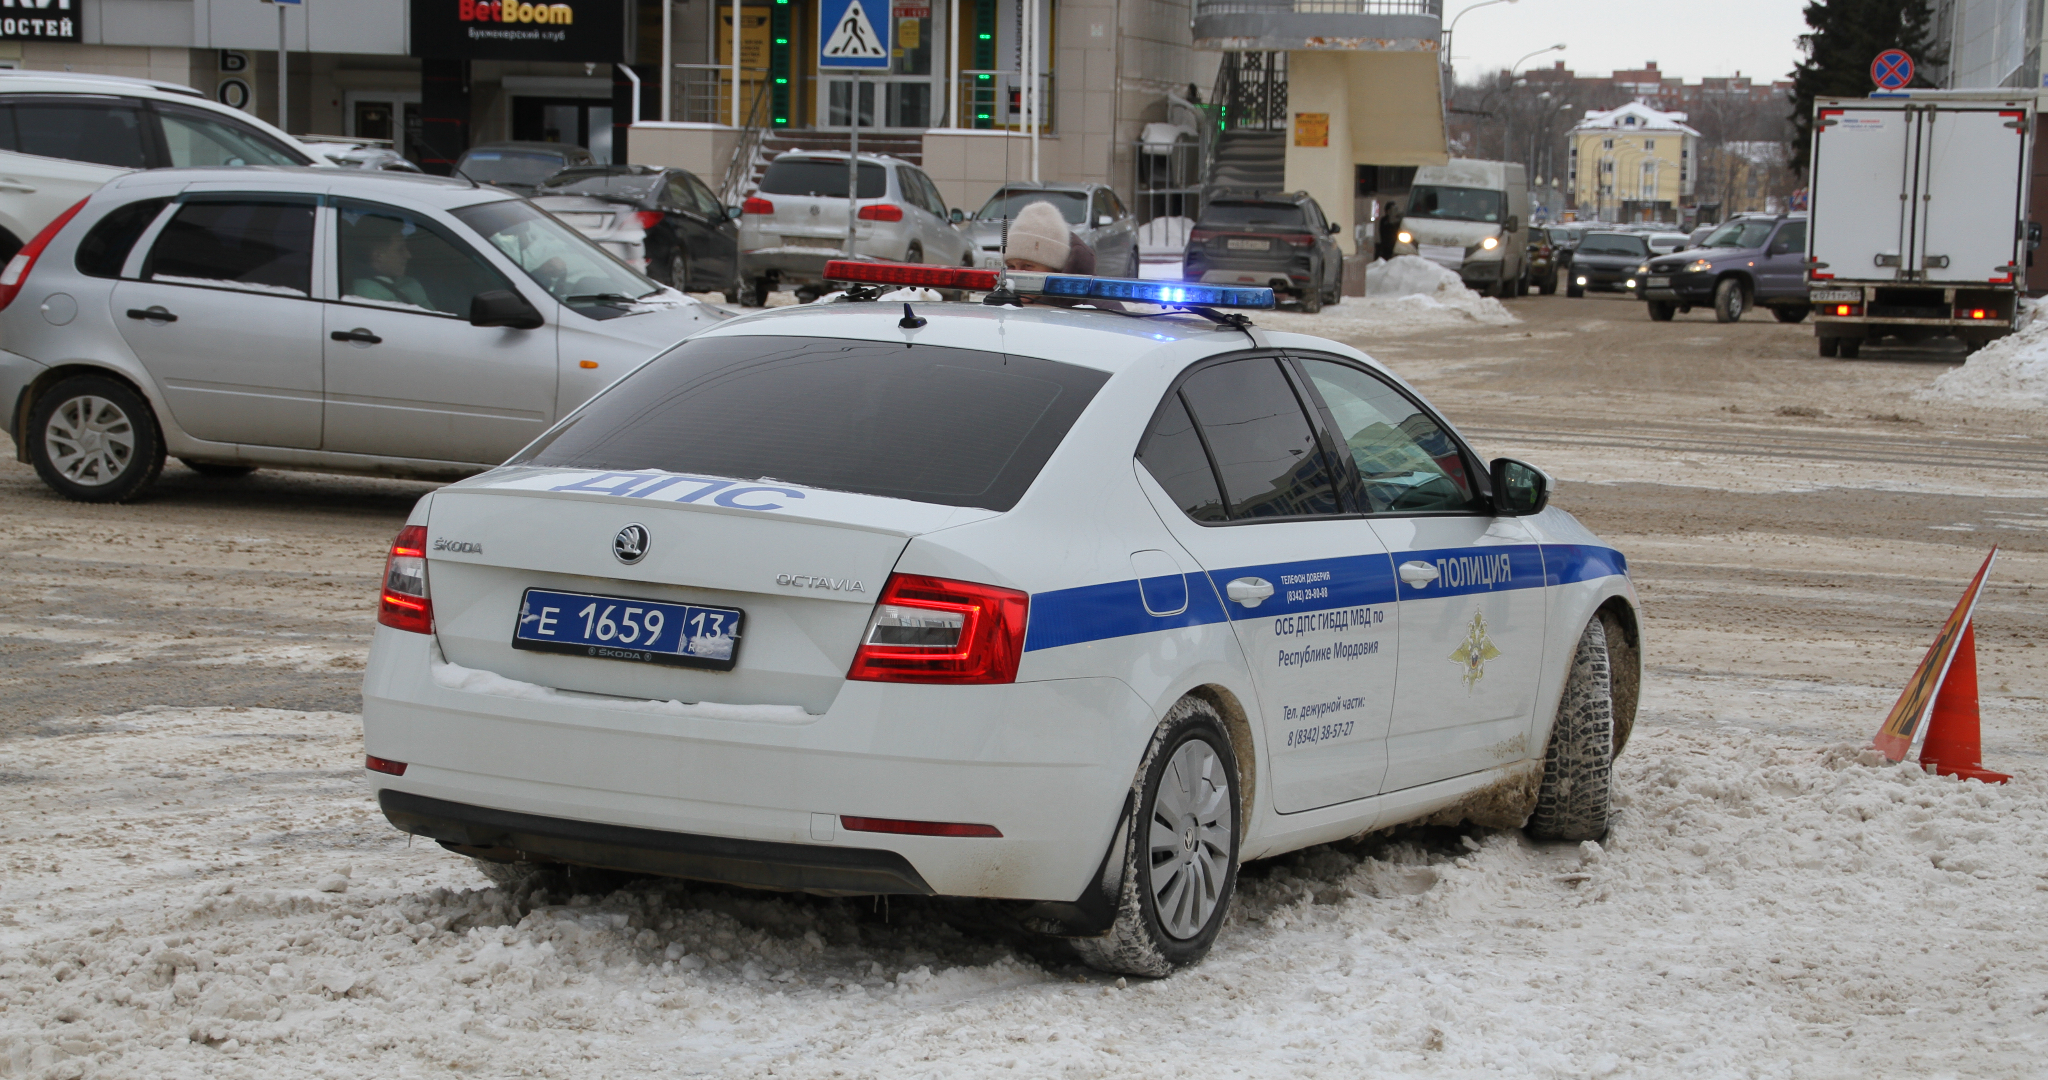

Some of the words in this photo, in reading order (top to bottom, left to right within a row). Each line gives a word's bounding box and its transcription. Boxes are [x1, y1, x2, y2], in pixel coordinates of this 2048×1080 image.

[459, 0, 573, 25] BetBoom
[0, 17, 74, 37] ОСТЕЙ
[468, 27, 540, 41] Букмекерский
[541, 30, 566, 42] клуб
[548, 472, 806, 511] ДПС
[433, 536, 484, 555] ŠKODA
[776, 573, 866, 593] OCTAVIA
[1280, 573, 1306, 585] ТЕЛЕФОН
[1306, 571, 1331, 584] ДОВЕРИЯ
[1436, 554, 1512, 590] ПОЛИЦИЯ
[1286, 588, 1305, 604] (8342)
[578, 602, 665, 646] 1659
[690, 612, 725, 640] 13
[1275, 617, 1295, 636] ОСБ
[1295, 614, 1316, 637] ДПС
[1318, 610, 1349, 632] ГИБДД
[1350, 607, 1372, 628] МВД
[1373, 610, 1384, 624] по
[598, 648, 641, 660] ŠKODA
[1278, 645, 1331, 668] Республике
[1333, 641, 1379, 661] Мордовия
[1283, 705, 1298, 720] Тел.
[1299, 696, 1341, 721] дежурной
[1342, 697, 1366, 711] части:
[1287, 731, 1294, 747] 8
[1294, 725, 1320, 748] (8342)
[1320, 720, 1355, 741] 38-57-27
